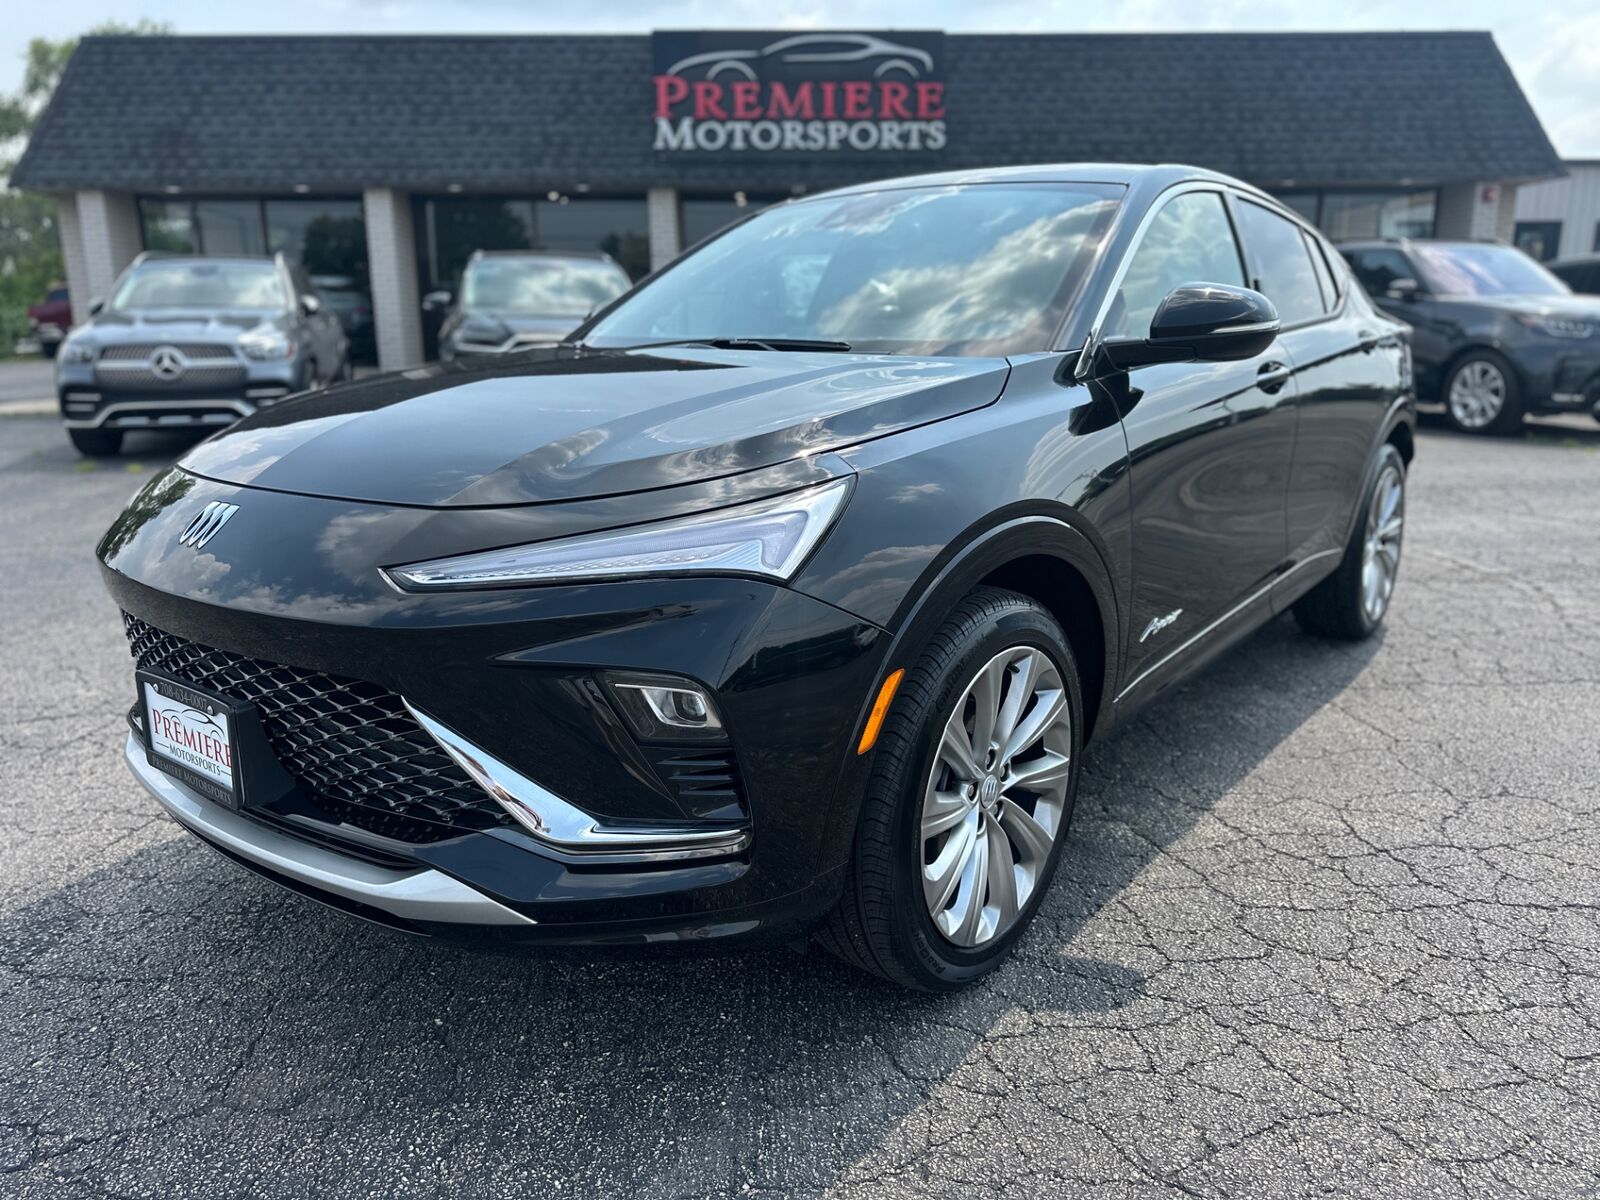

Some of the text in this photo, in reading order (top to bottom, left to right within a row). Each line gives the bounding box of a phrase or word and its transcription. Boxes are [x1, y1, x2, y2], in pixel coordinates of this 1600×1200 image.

[652, 75, 946, 119] PREMIERE
[653, 117, 947, 150] MOTORSPORTS
[169, 743, 221, 776] MOTORSPORTS
[184, 770, 231, 804] MOTORSPORTS
